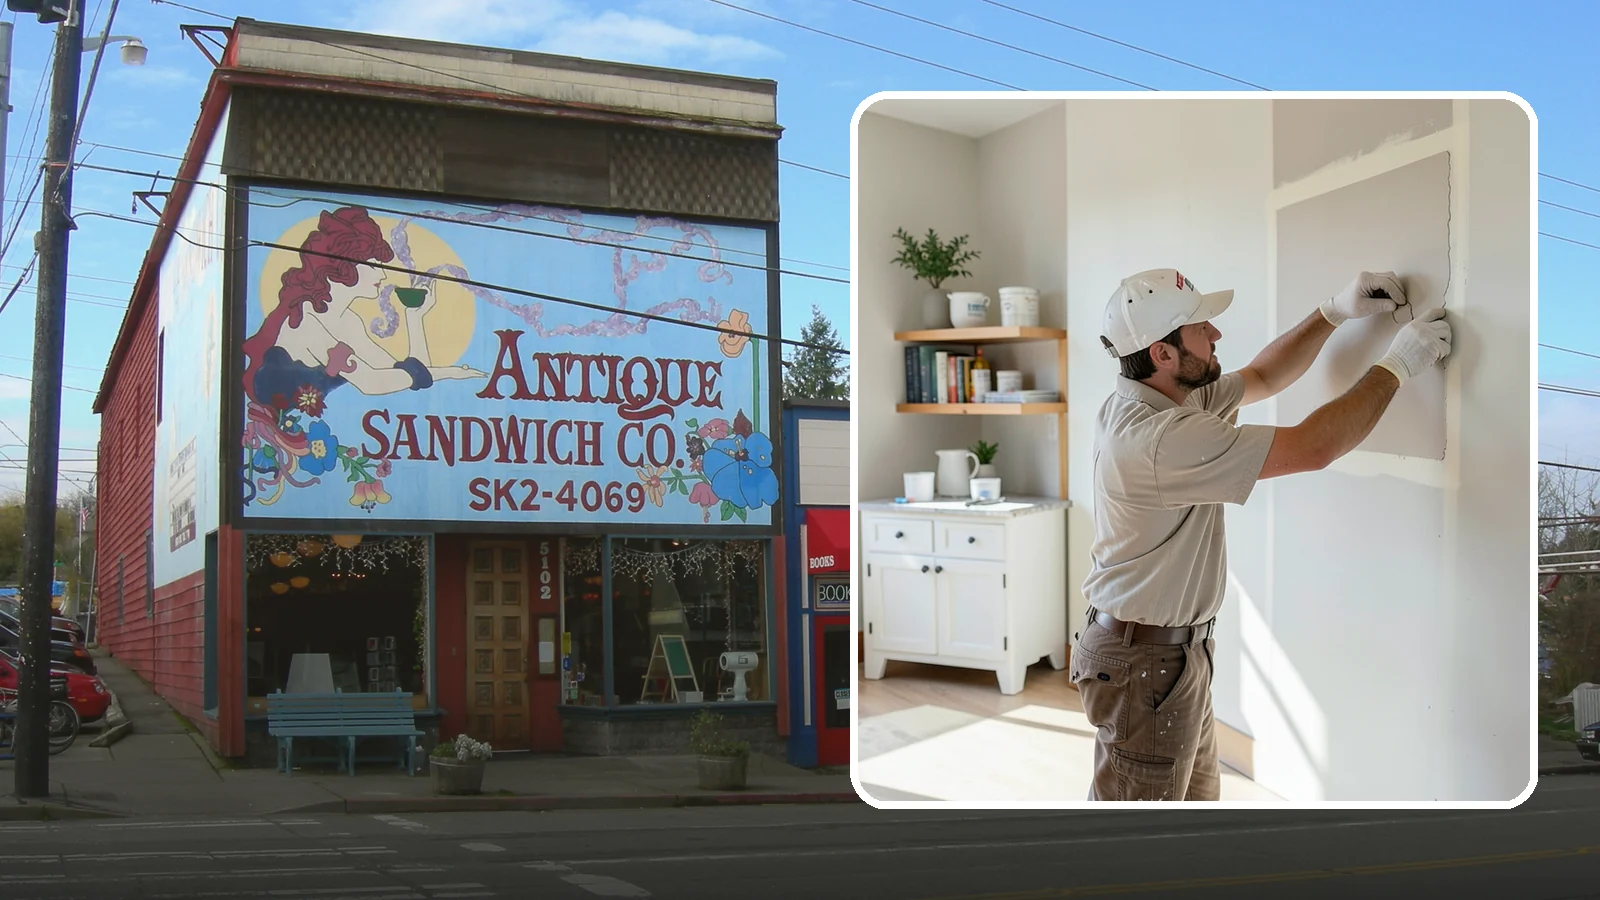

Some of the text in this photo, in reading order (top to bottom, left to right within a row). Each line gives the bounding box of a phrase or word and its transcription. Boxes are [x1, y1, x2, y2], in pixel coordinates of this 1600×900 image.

[475, 329, 723, 421] ANTIQUE
[361, 408, 685, 469] SANDWICH CO.
[468, 477, 646, 513] SK2-4069
[540, 541, 551, 600] 5102
[809, 555, 835, 569] BOOKS
